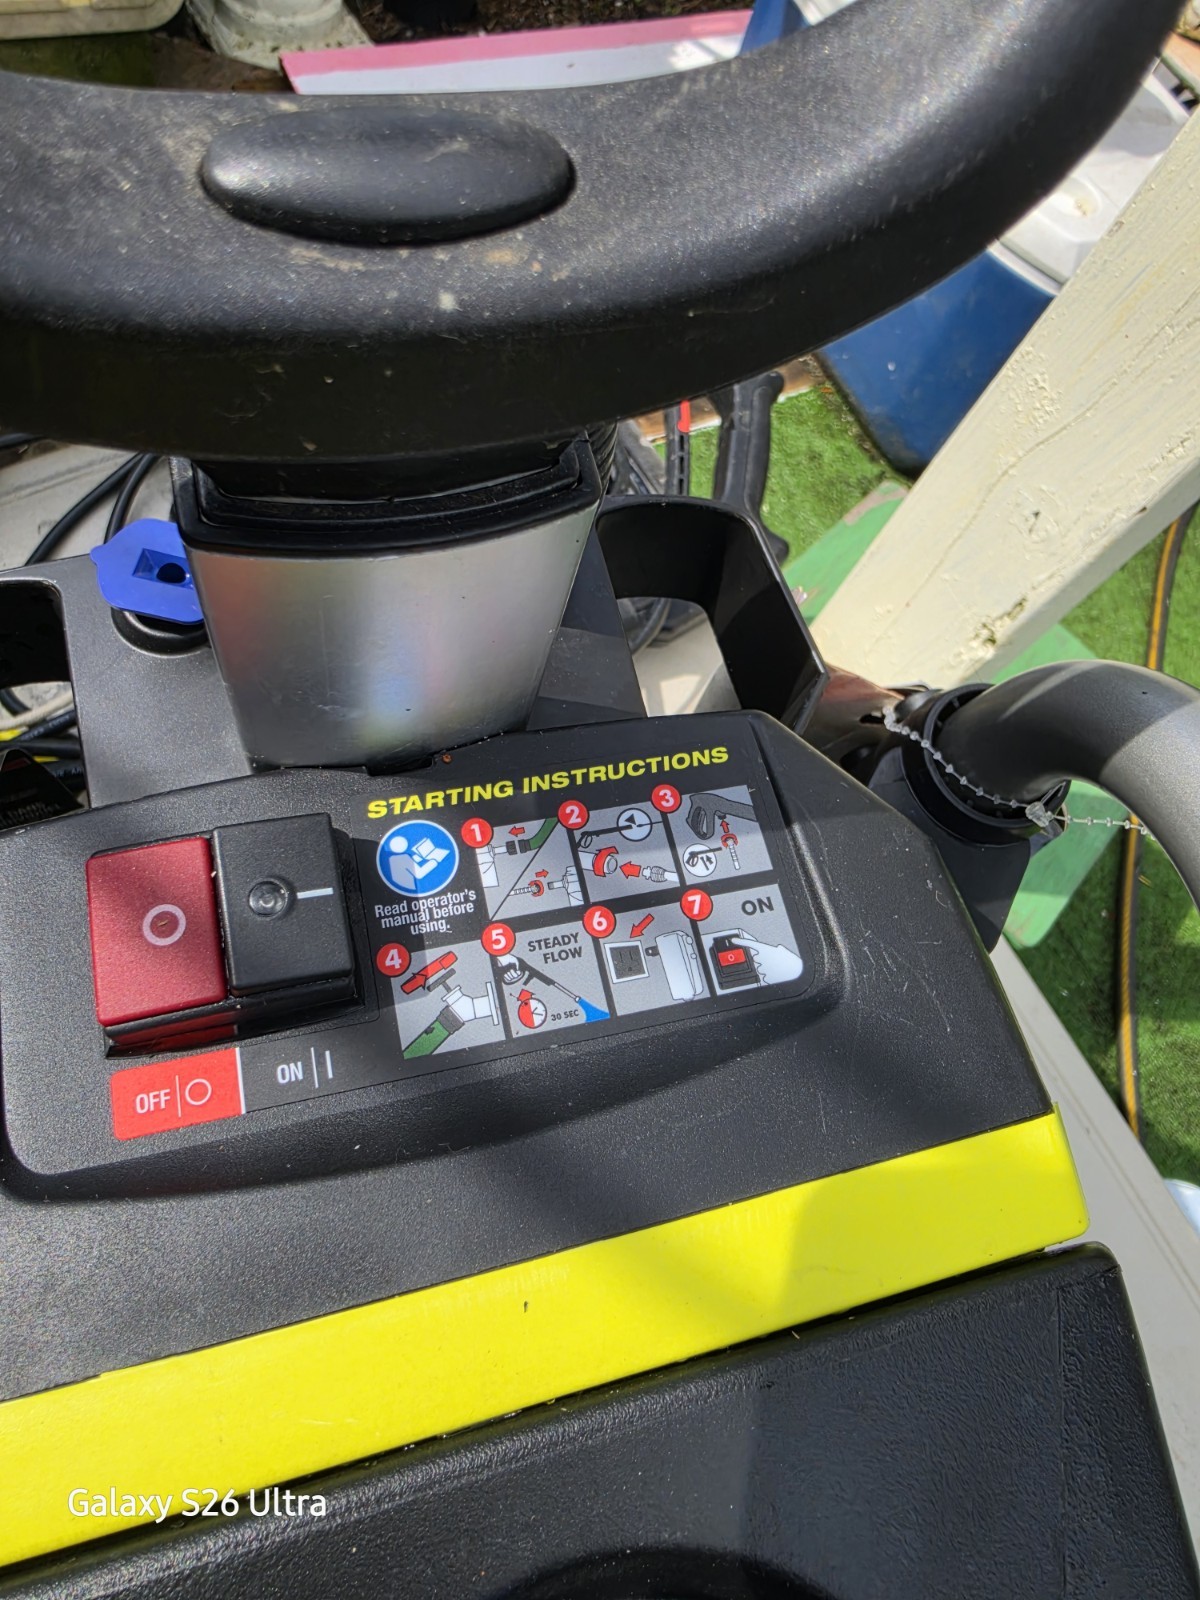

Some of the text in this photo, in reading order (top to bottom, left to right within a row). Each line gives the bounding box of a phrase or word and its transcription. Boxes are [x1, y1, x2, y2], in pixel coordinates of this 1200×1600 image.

[367, 746, 729, 819] STARTING INSTRUCTIONS
[658, 789, 675, 808] 3
[565, 805, 582, 824] 2
[471, 824, 482, 842] 1
[374, 889, 477, 918] Read operator's
[687, 894, 702, 915] 7
[741, 896, 775, 916] ON
[381, 902, 475, 929] manual before
[592, 911, 607, 932] 6
[410, 920, 451, 935] using.
[491, 928, 507, 950] 5
[527, 932, 580, 952] STEADY
[384, 948, 402, 969] 4
[542, 946, 583, 964] FLOW
[550, 1009, 580, 1022] 30 SEC
[276, 1061, 303, 1084] ON
[135, 1088, 171, 1114] OFF
